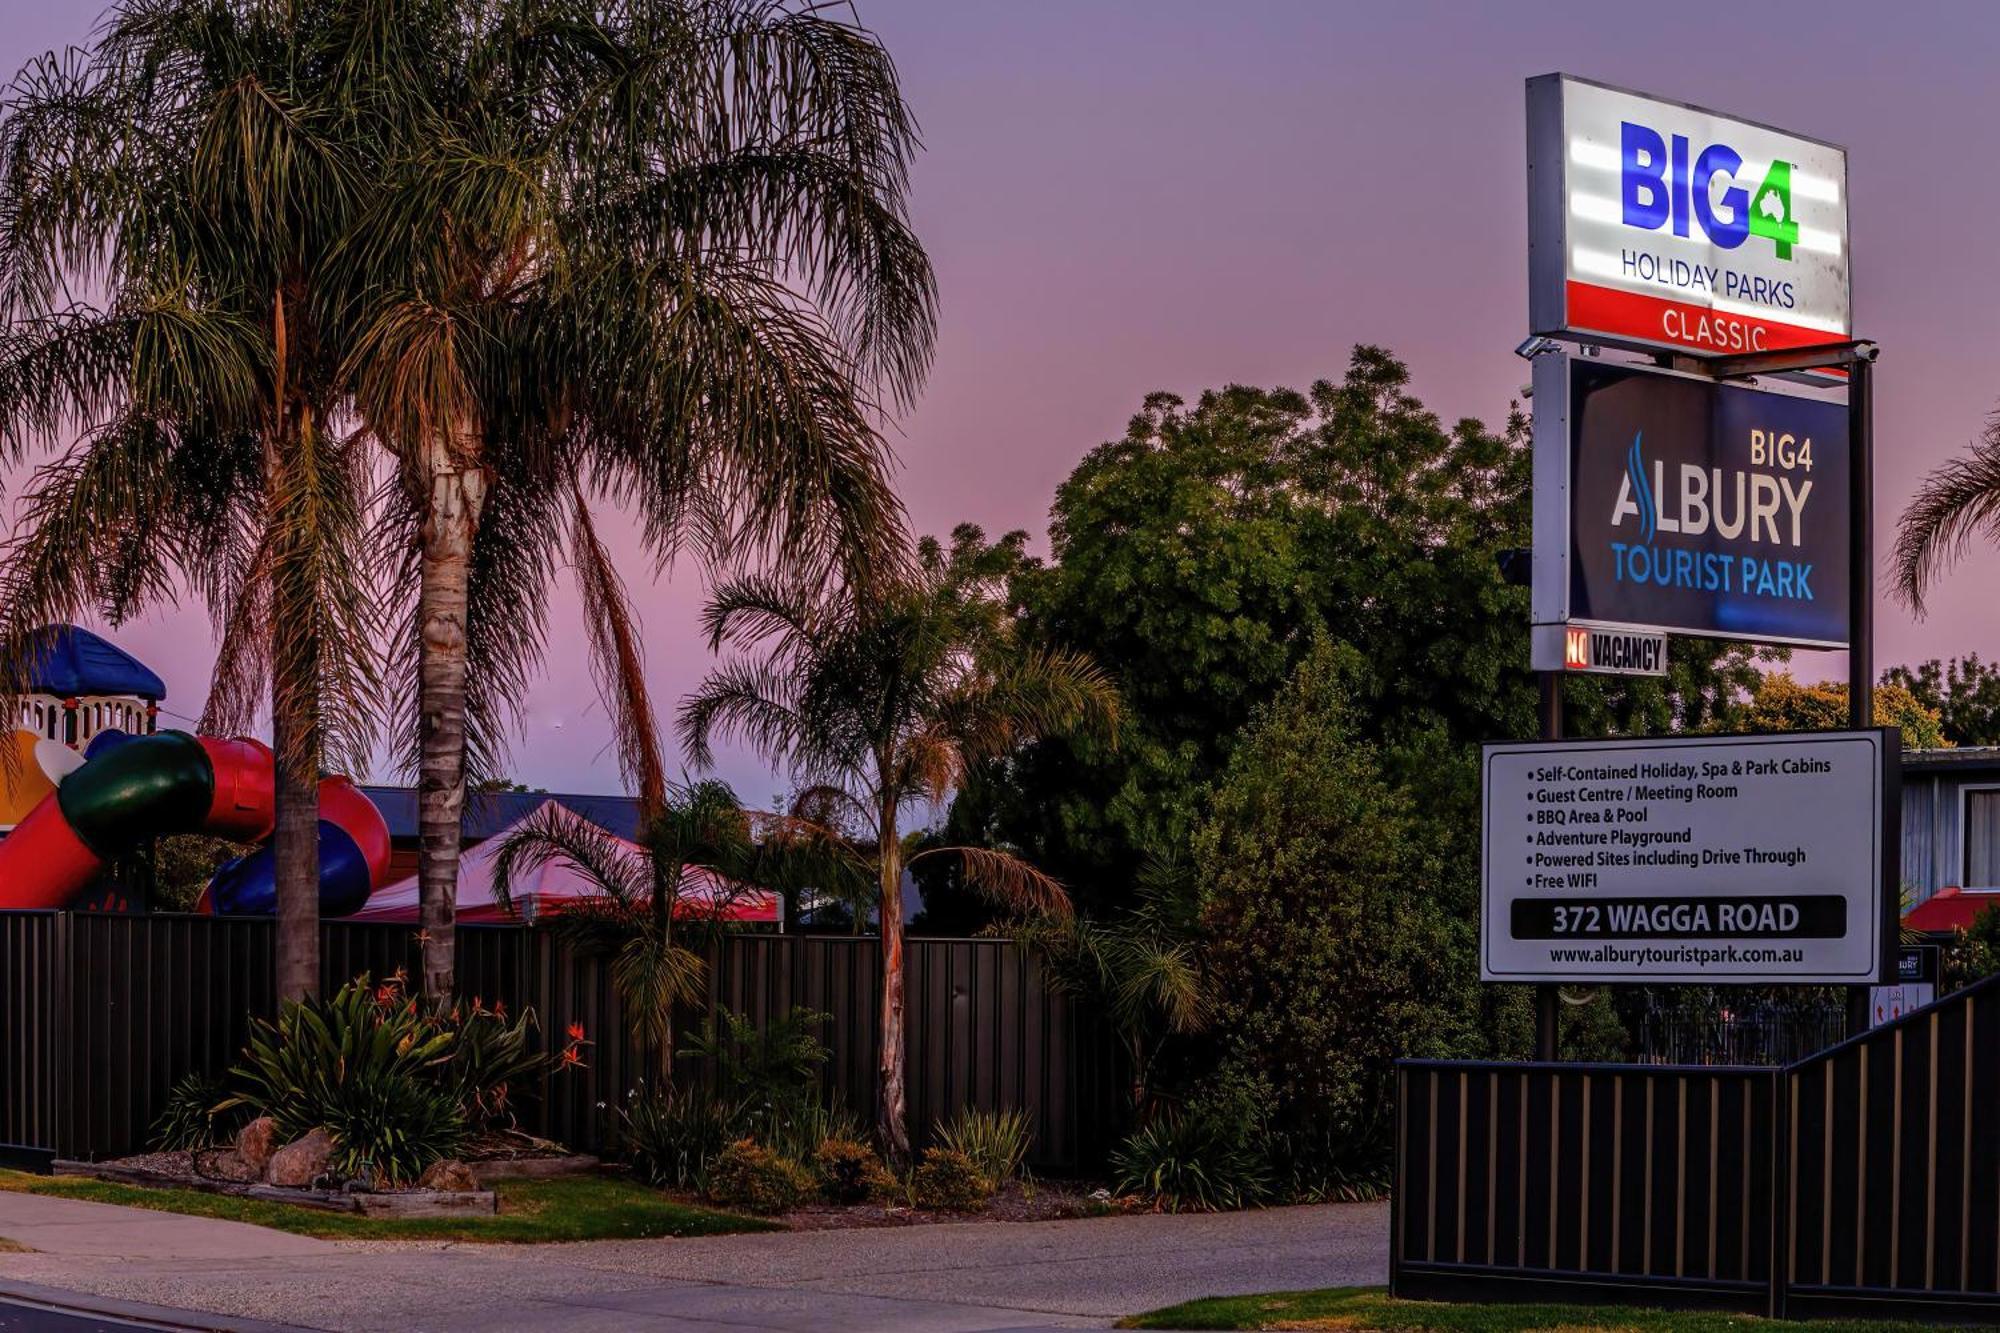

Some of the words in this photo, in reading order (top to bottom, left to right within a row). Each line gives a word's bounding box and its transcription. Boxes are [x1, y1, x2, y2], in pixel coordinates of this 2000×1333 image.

[1621, 121, 1799, 261] BIG4
[1622, 249, 1718, 291] HOLIDAY
[1726, 271, 1795, 309] PARKS
[1664, 309, 1767, 352] CLASSIC
[1751, 429, 1813, 472] BIG4
[1612, 460, 1813, 547] ALBURY
[1611, 543, 1734, 592] TOURIST
[1742, 558, 1813, 600] PARK
[1567, 631, 1588, 664] NO
[1592, 634, 1662, 671] VACANCY
[1537, 764, 1638, 781] Self-Contained
[1642, 763, 1698, 780] Holiday,
[1702, 762, 1728, 778] Spa
[1732, 762, 1742, 774] &
[1746, 760, 1778, 775] Park
[1781, 758, 1831, 773] Cabins
[1537, 789, 1575, 802] Guest
[1578, 788, 1623, 802] Centre
[1627, 787, 1632, 801] /
[1635, 786, 1693, 803] Meeting
[1697, 784, 1738, 799] Room
[1537, 810, 1565, 826] BBQ
[1569, 810, 1600, 824] Area
[1604, 809, 1613, 822] &
[1617, 807, 1647, 822] Pool
[1537, 831, 1607, 846] Adventure
[1611, 828, 1691, 847] Playground
[1536, 852, 1593, 867] Powered
[1597, 852, 1630, 866] Sites
[1633, 850, 1698, 868] including
[1703, 850, 1740, 865] Drive
[1744, 848, 1806, 866] Through
[1535, 874, 1564, 888] Free
[1568, 873, 1597, 888] WIFI
[1553, 907, 1599, 933] 372
[1608, 904, 1710, 932] WAGGA
[1719, 904, 1799, 931] ROAD
[1550, 945, 1803, 965] www.alburytouristpark.com.au
